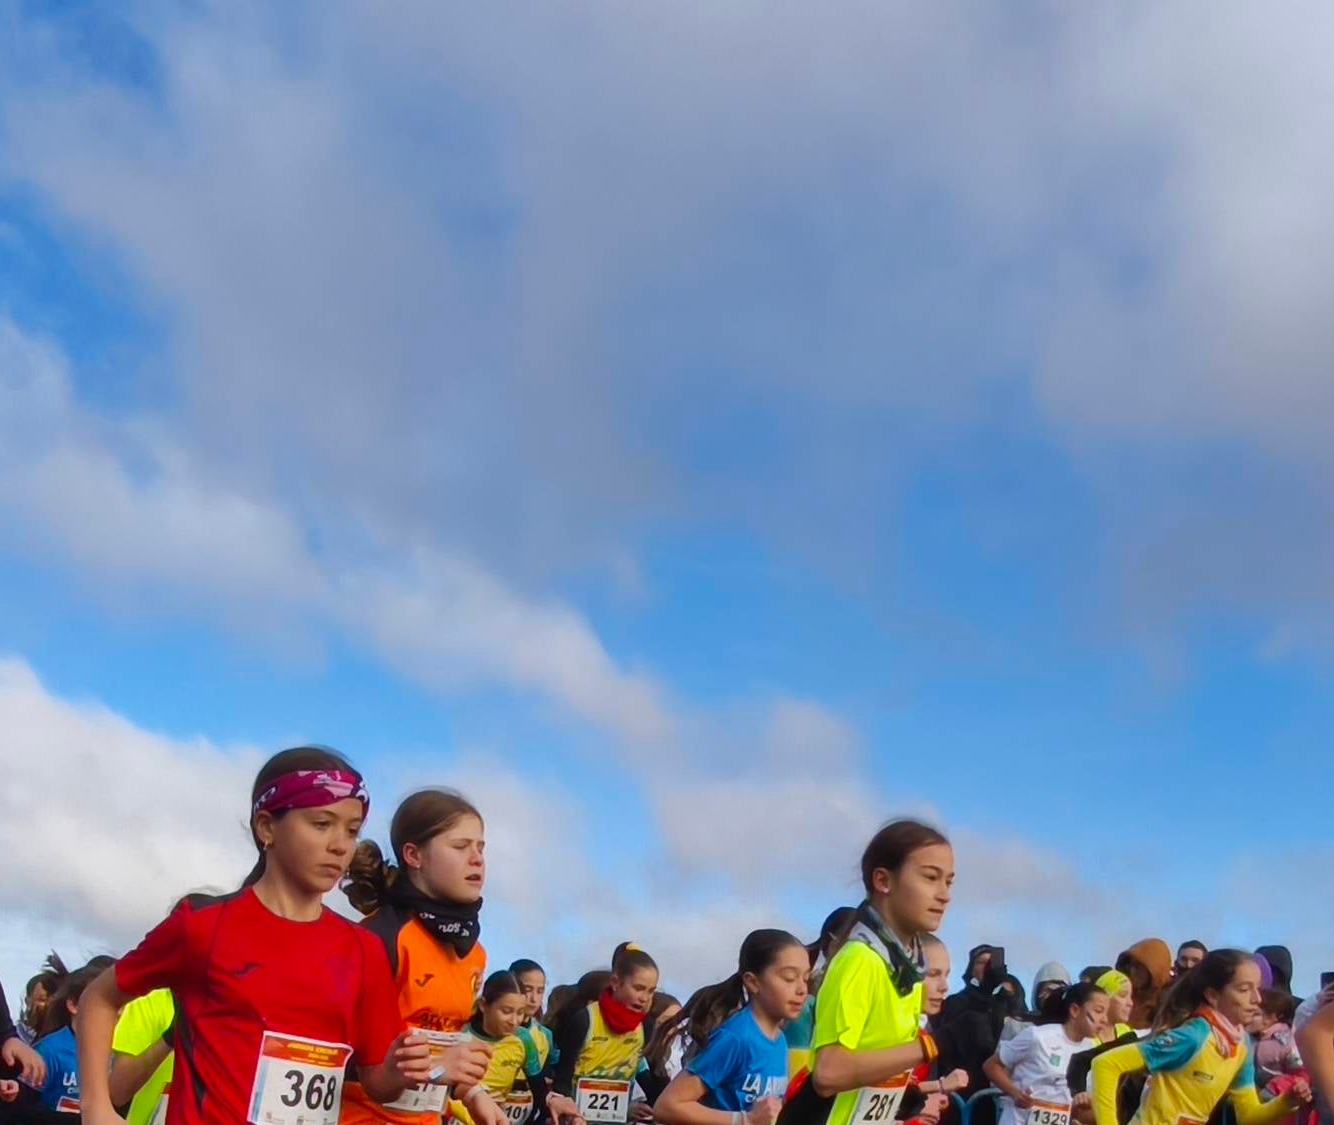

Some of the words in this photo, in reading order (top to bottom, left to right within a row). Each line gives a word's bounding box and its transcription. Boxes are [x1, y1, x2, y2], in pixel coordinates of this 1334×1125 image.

[280, 1069, 337, 1111] 368
[587, 1093, 620, 1111] 221
[862, 1092, 897, 1121] 281
